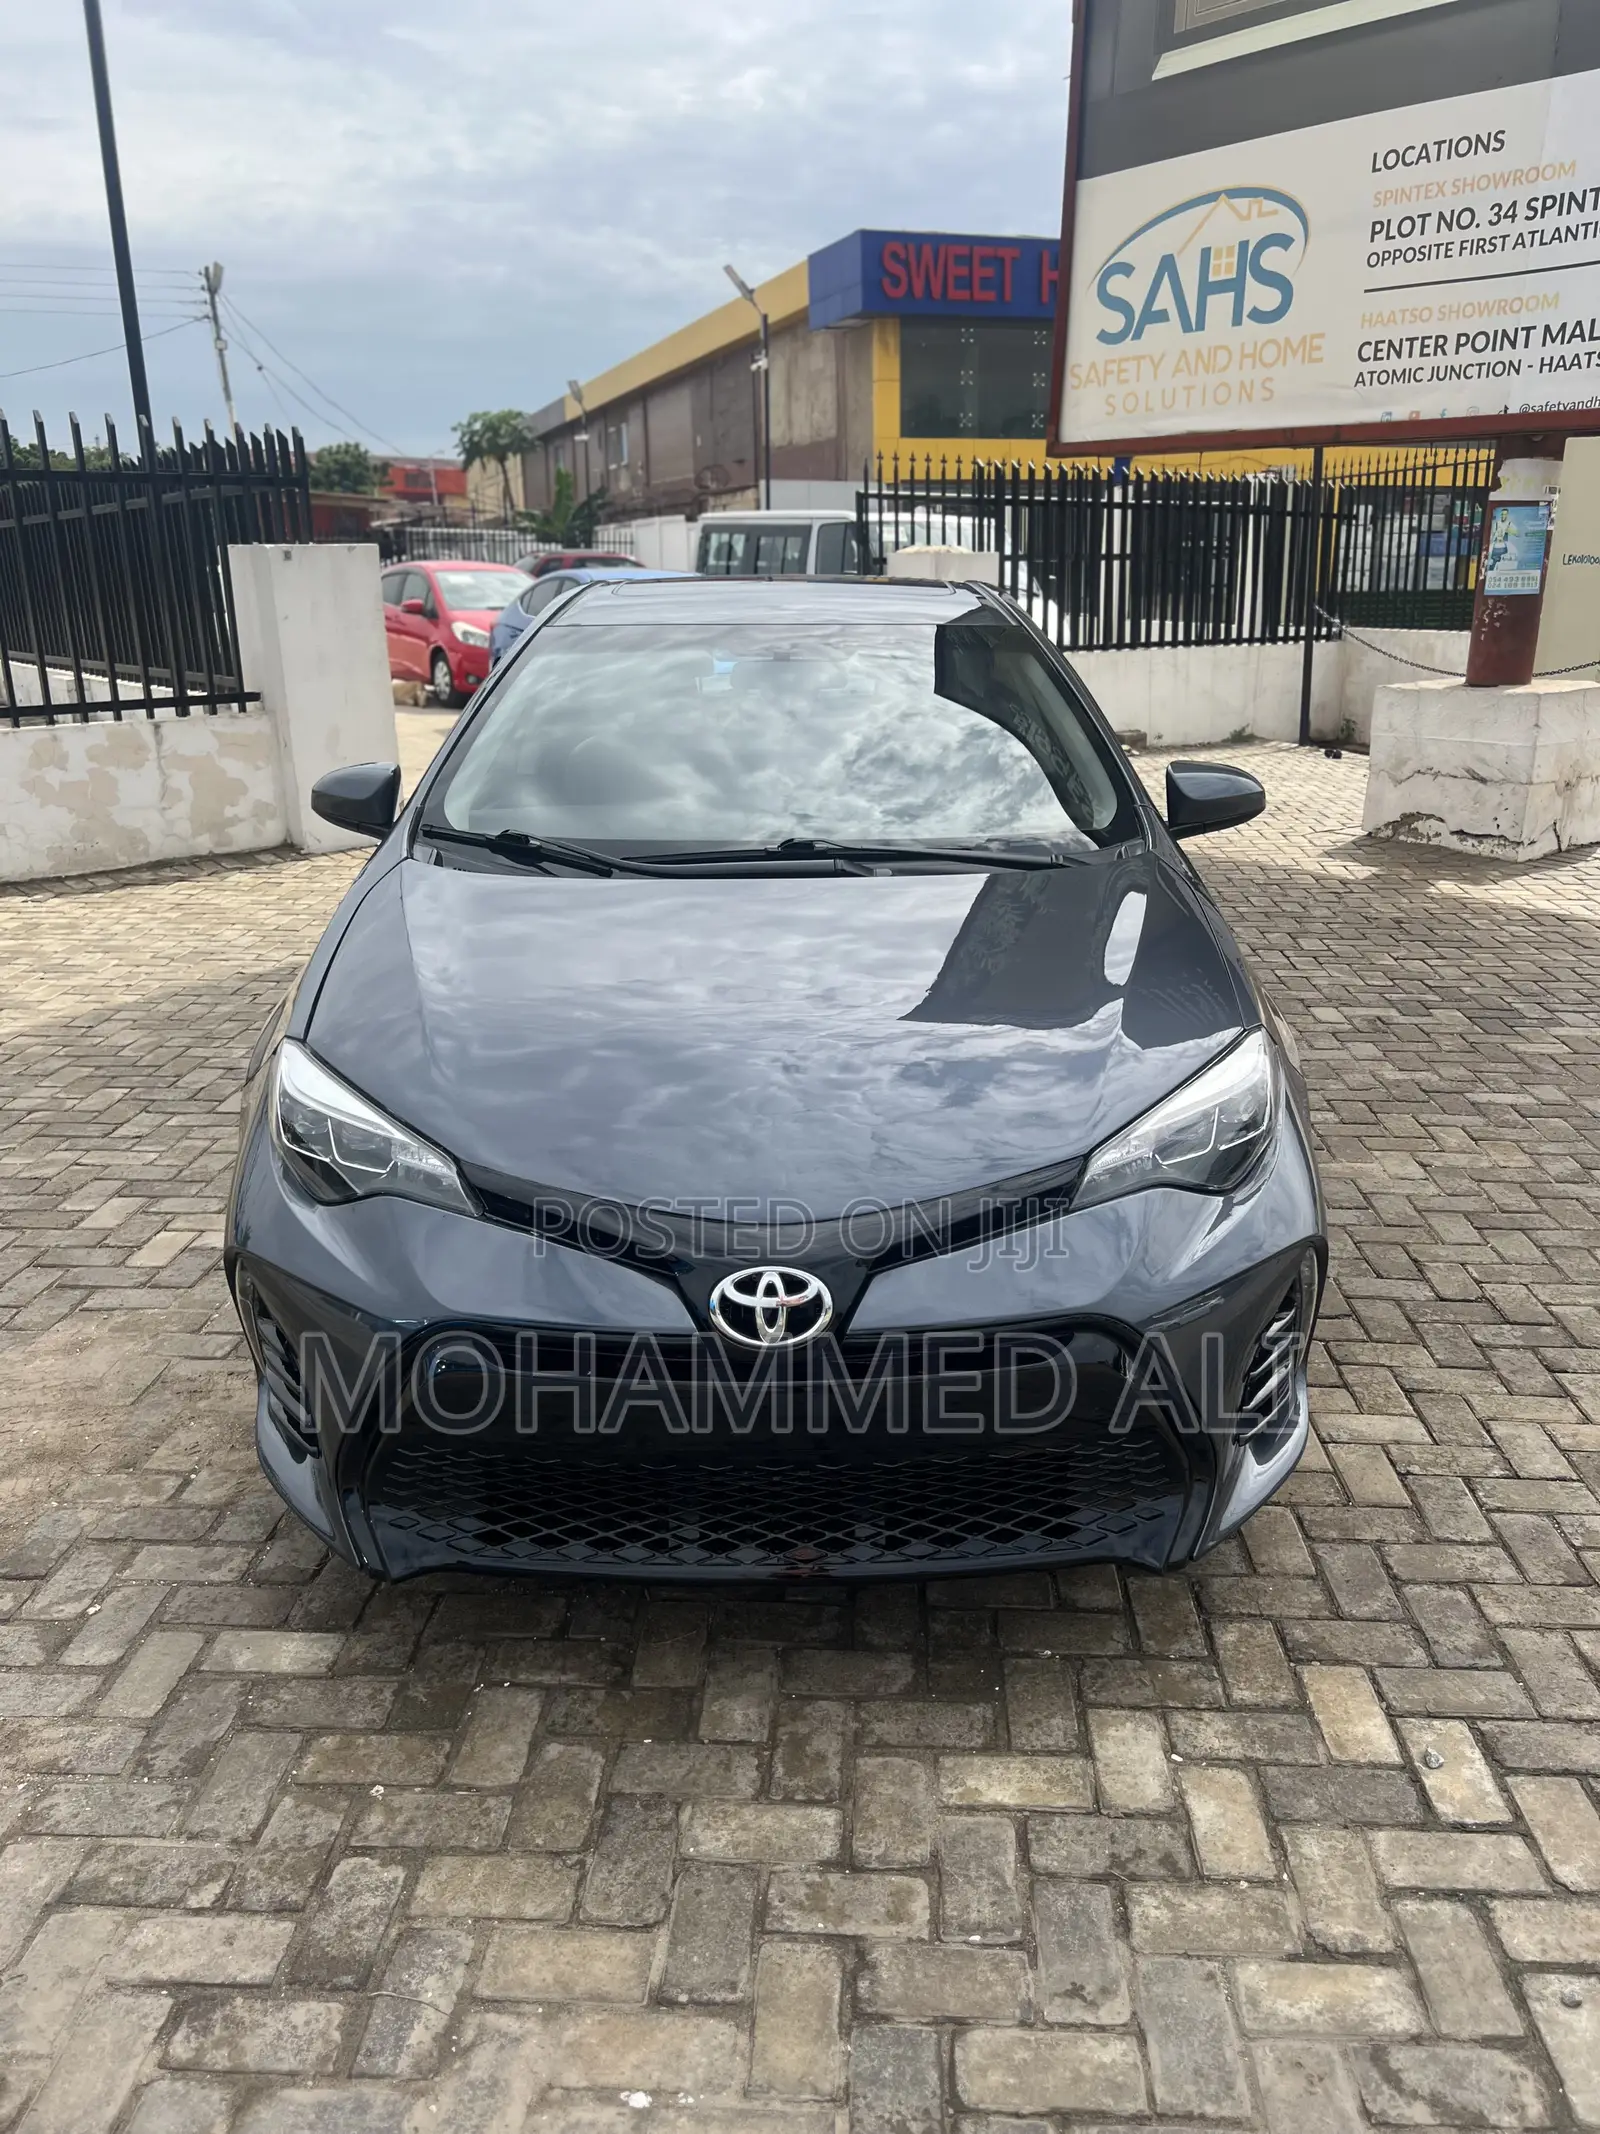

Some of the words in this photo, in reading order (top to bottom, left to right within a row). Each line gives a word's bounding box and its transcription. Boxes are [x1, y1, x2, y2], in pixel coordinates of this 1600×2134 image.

[1371, 129, 1506, 173] LOCATIONS
[1372, 180, 1447, 208] SPINTEX
[1451, 159, 1577, 196] SHOWROOM
[1366, 241, 1455, 268] OPPOSITE
[1458, 233, 1511, 257] FIRST
[1512, 220, 1600, 251] ATLANTI
[1369, 212, 1432, 243] PLOT
[1436, 206, 1481, 234] NO.
[1487, 199, 1518, 227] 34
[880, 241, 1021, 303] SWEET
[1096, 232, 1296, 346] SAHS
[1360, 305, 1433, 330] HAATSO
[1437, 291, 1560, 321] SHOWROOM
[1069, 352, 1167, 391] SAFETY
[1171, 344, 1234, 379] AND
[1238, 332, 1326, 371] HOME
[1357, 334, 1448, 363] CENTER
[1454, 325, 1537, 355] POINT
[1541, 317, 1600, 348] MAL
[1354, 366, 1424, 388] ATOMIC
[1427, 358, 1522, 382] JUNCTION
[1104, 376, 1275, 417] SOLUTIONS
